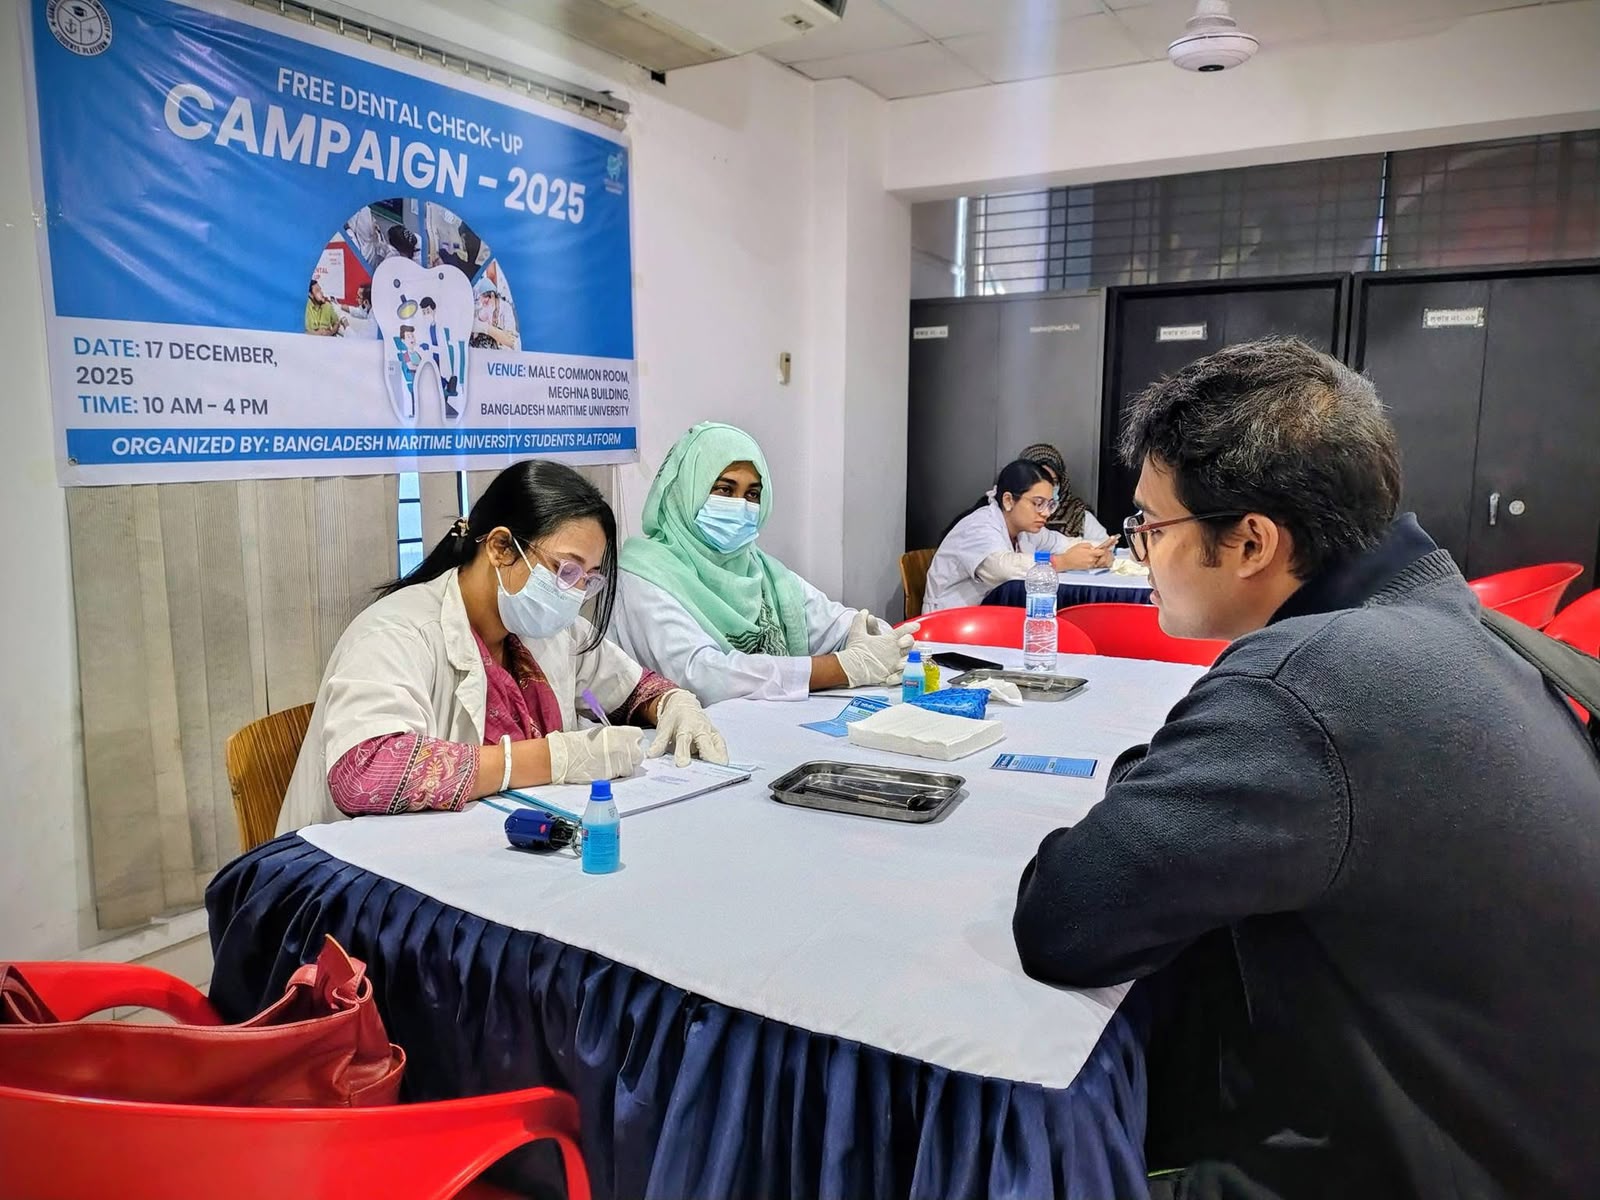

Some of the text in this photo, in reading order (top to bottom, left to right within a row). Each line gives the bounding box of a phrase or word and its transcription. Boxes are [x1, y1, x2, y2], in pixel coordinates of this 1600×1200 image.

[277, 66, 524, 156] FREE DENTAL CHECK-UP
[163, 83, 468, 198] CAMPAIGN
[504, 166, 586, 225] 2025
[73, 336, 278, 367] DATE: 17 DECEMBER,
[76, 366, 134, 386] 2025
[487, 362, 630, 384] VENUE: MALE COMMON ROOM,
[548, 385, 630, 402] MEGHNA BUILDING,
[78, 395, 139, 414] TIME:
[142, 396, 164, 414] 10
[170, 397, 203, 415] AM
[223, 398, 236, 415] 4
[240, 398, 268, 415] PM
[480, 403, 629, 417] BANGLADESH MARITIME UNIVERSITY
[111, 432, 621, 455] ORGANIZED BY: BANGLADESH MARITIME UNIVERSITY STUDENTS PLATFORM
